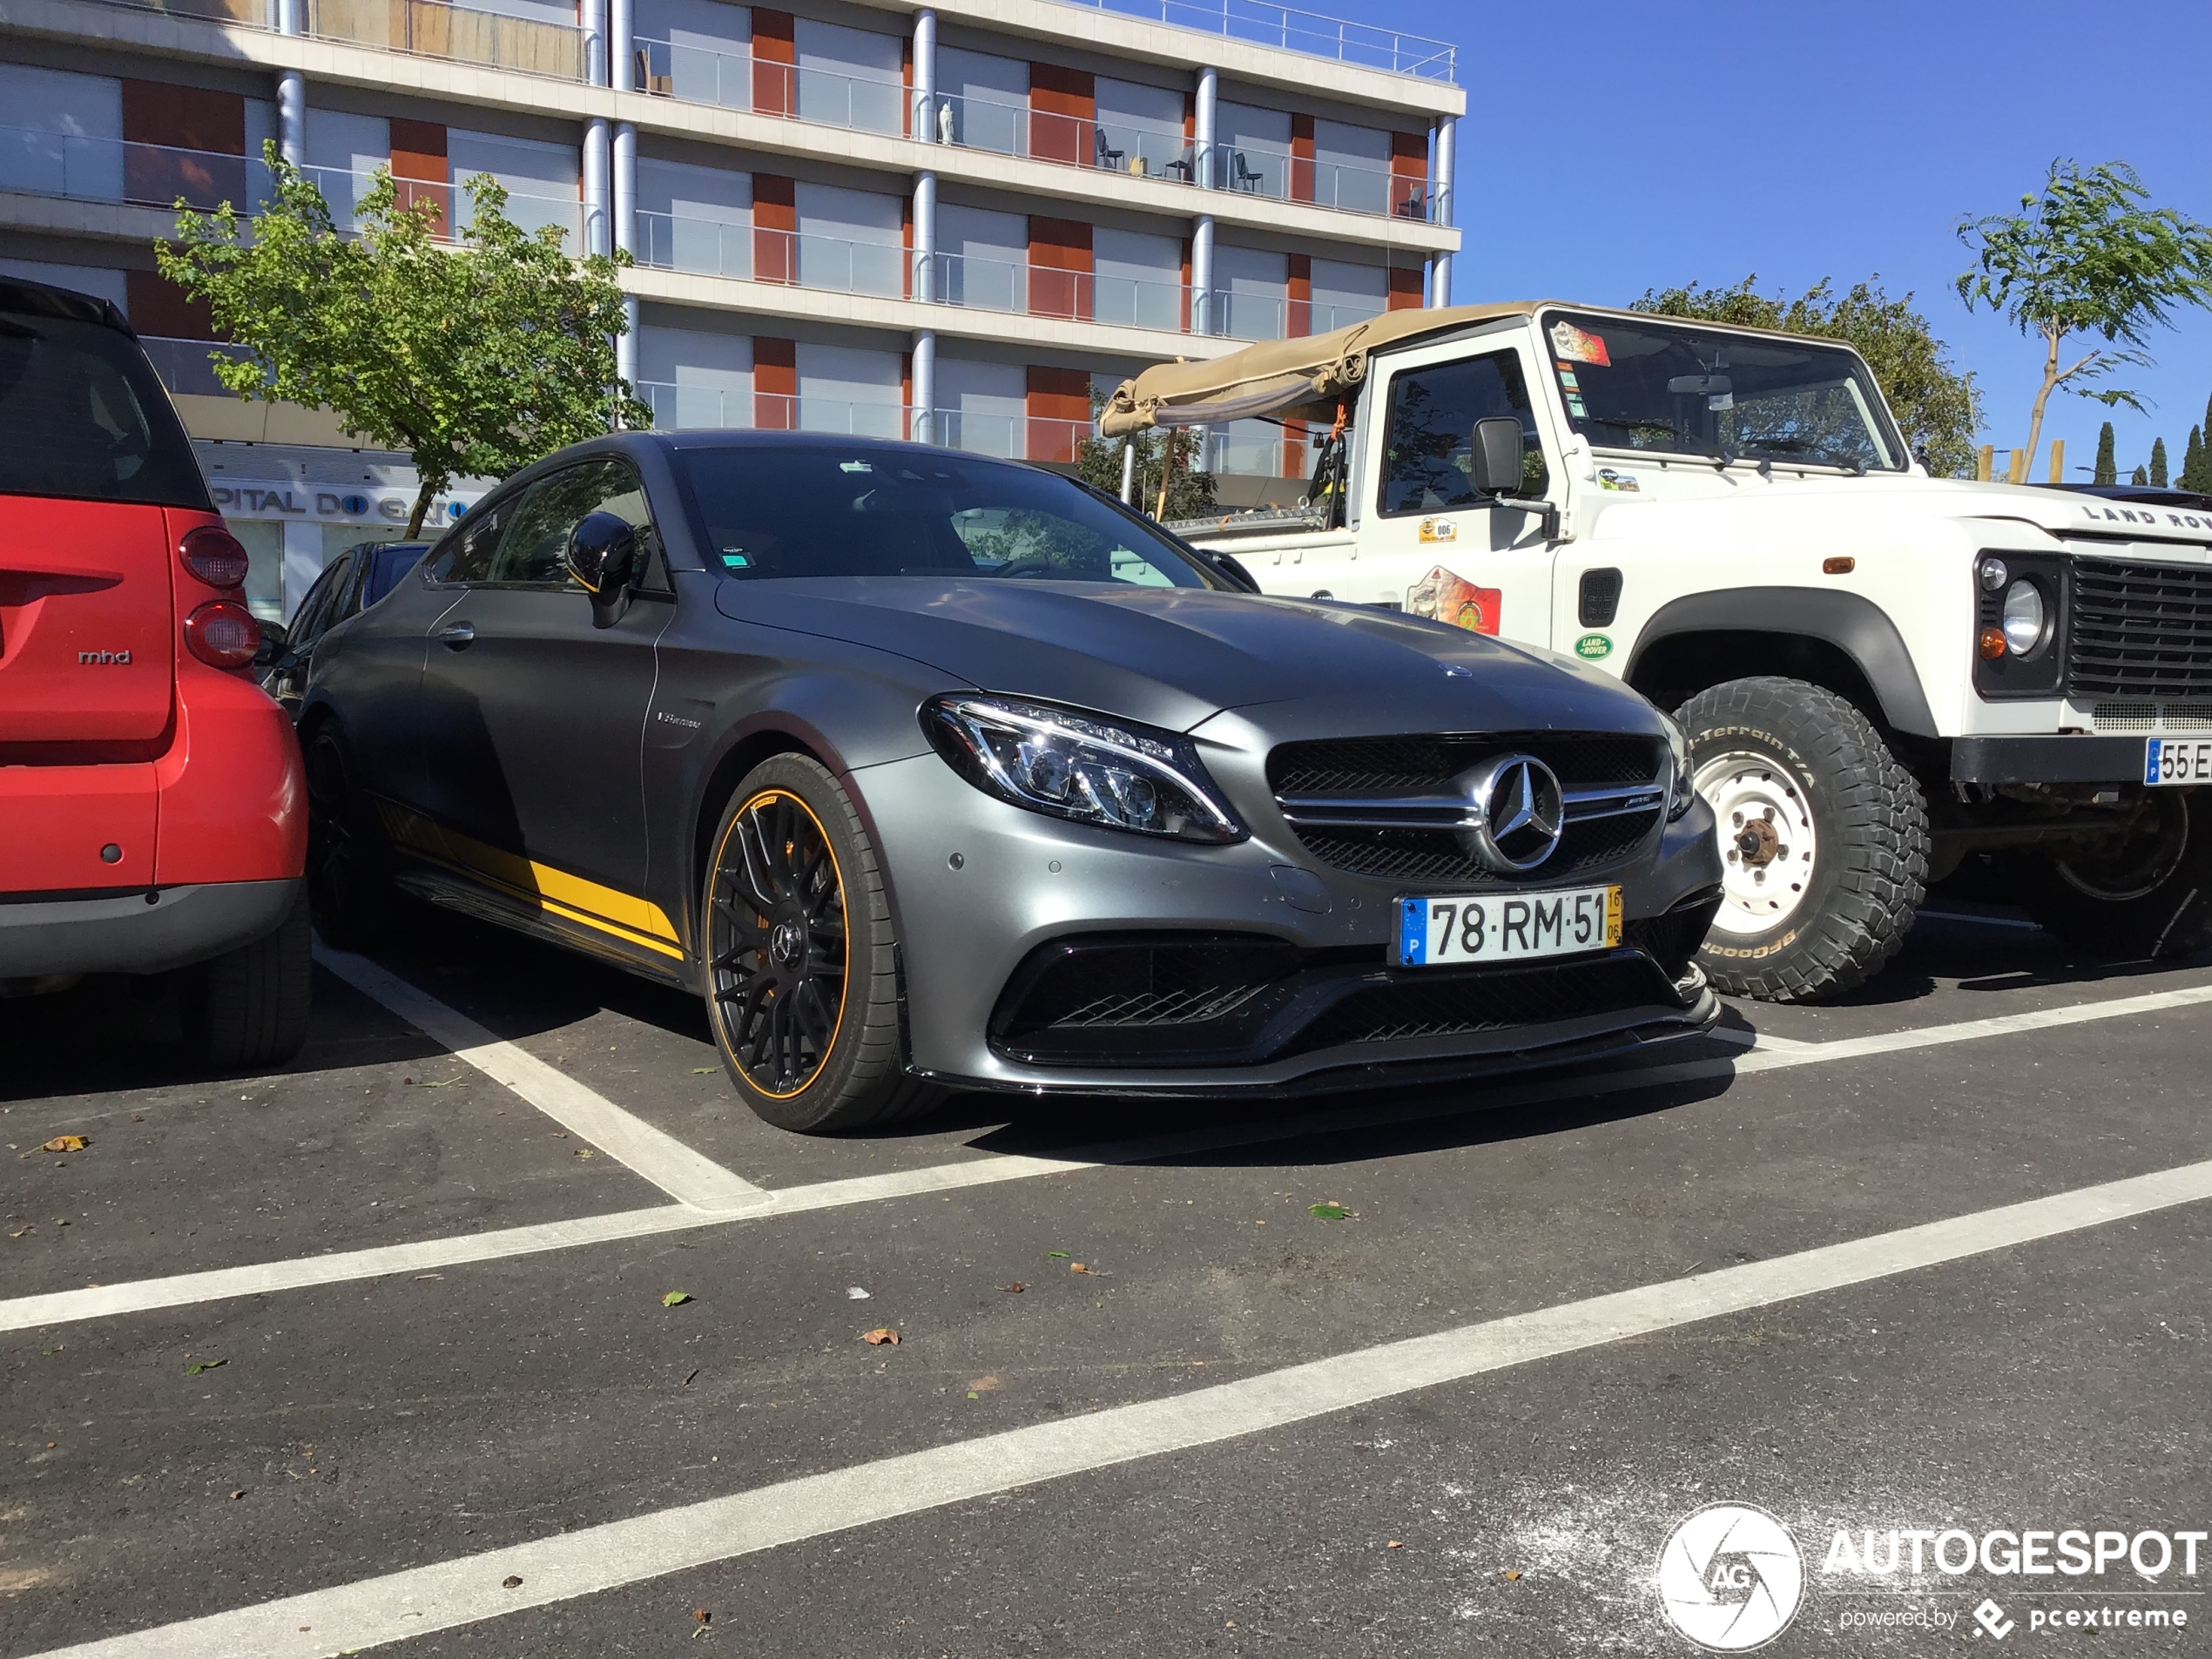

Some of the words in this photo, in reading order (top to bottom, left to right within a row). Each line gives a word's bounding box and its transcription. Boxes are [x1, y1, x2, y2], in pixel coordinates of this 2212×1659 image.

[317, 493, 368, 516] DO
[2081, 506, 2155, 523] LAND
[1438, 524, 1451, 536] 006
[1582, 638, 1602, 647] LAND
[78, 649, 131, 664] mhd
[1583, 646, 1608, 655] ROVER
[1788, 747, 1815, 789] T/A
[2162, 745, 2212, 779] 55·E
[2150, 767, 2156, 777] P
[1608, 892, 1620, 908] 16
[1607, 923, 1619, 940] 06
[1409, 939, 1420, 954] P
